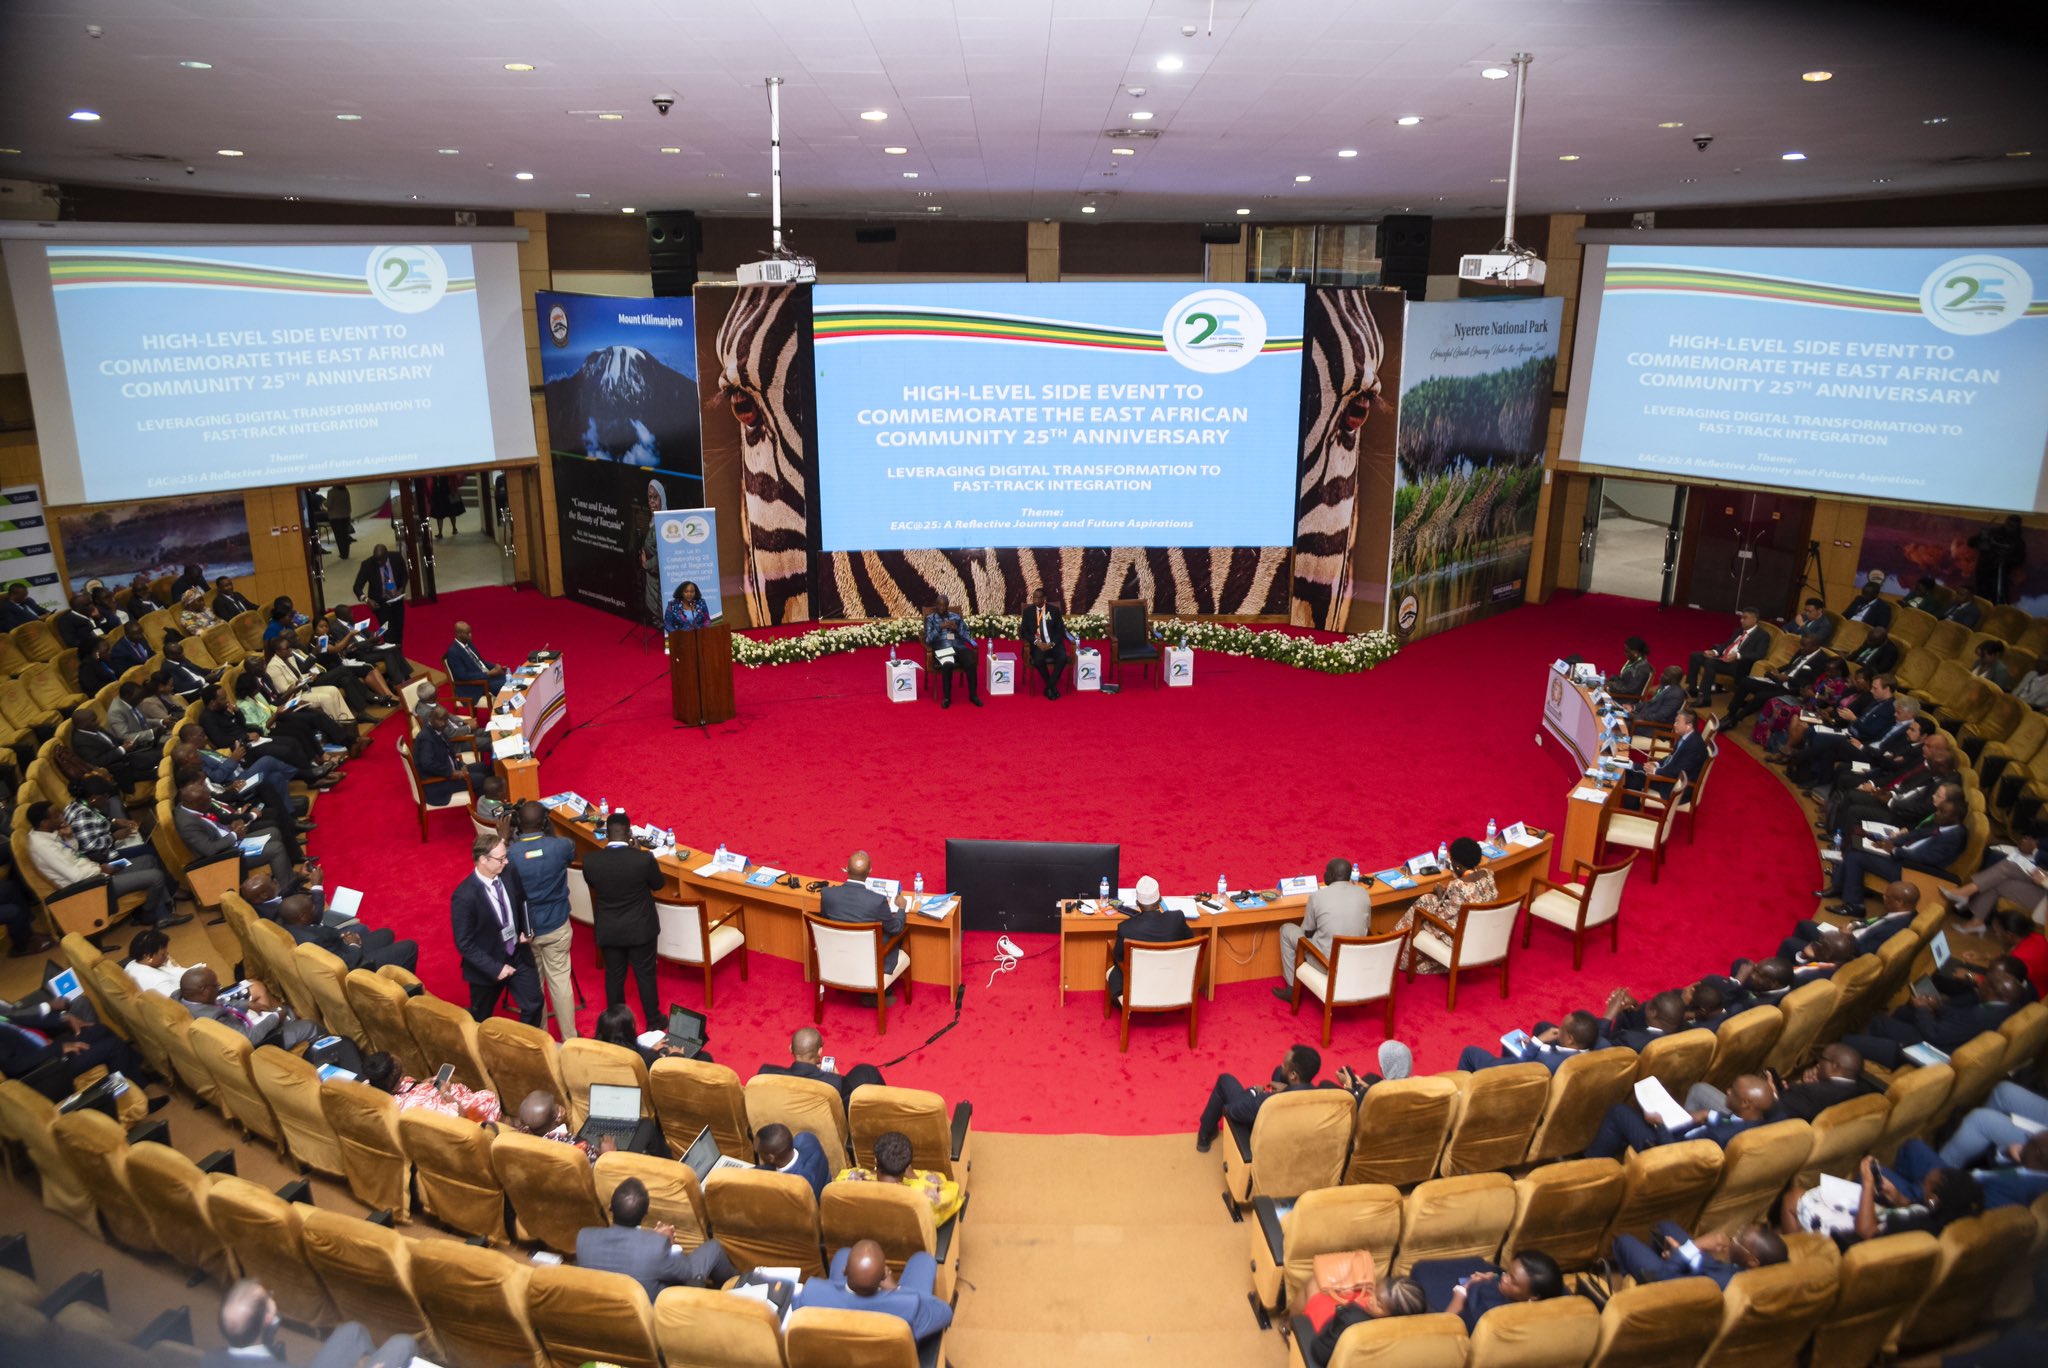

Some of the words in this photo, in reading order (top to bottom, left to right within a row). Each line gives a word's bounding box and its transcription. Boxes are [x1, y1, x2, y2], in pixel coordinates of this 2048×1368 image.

[1944, 276, 2006, 307] 25
[618, 313, 641, 325] Mount
[641, 313, 683, 328] Kilimanjaro
[1185, 312, 1242, 344] 25
[1454, 323, 1490, 340] Nyerere
[1491, 320, 1528, 335] National
[1528, 319, 1548, 333] Park
[143, 330, 267, 350] HIGH-LEVEL
[272, 328, 316, 344] SIDE
[320, 325, 379, 342] EVENT
[382, 324, 407, 339] TO
[1668, 335, 1787, 353] HIGH-LEVEL
[1793, 340, 1840, 356] SIDE
[1846, 342, 1919, 359] EVENT
[1923, 344, 1955, 360] TO
[99, 352, 272, 376] COMMEMORATE
[274, 350, 313, 366] THE
[317, 347, 362, 364] EAST
[367, 343, 445, 361] AFRICAN
[1627, 352, 1786, 374] COMMEMORATE
[1791, 360, 1831, 376] THE
[1836, 363, 1891, 379] EAST
[1895, 365, 2000, 384] AFRICAN
[121, 375, 255, 398] COMMUNITY
[305, 364, 433, 387] ANNIVERSARY
[903, 384, 1036, 401] HIGH-LEVEL
[1042, 384, 1092, 400] SIDE
[1097, 384, 1170, 400] EVENT
[1174, 384, 1204, 400] TO
[1639, 372, 1765, 393] COMMUNITY
[1815, 383, 1977, 405] ANNIVERSARY
[137, 413, 232, 431] LEVERAGING
[235, 409, 289, 424] DIGITAL
[293, 399, 413, 419] TRANSFORMATION
[414, 398, 432, 409] TO
[857, 407, 1038, 425] COMMEMORATE
[1042, 406, 1085, 422] THE
[1090, 406, 1146, 422] EAST
[1150, 407, 1248, 423] AFRICAN
[1643, 405, 1730, 421] LEVERAGING
[1734, 411, 1790, 425] DIGITAL
[1793, 414, 1937, 435] TRANSFORMATION
[1940, 424, 1963, 436] TO
[203, 425, 287, 442] FAST-TRACK
[290, 417, 379, 435] INTEGRATION
[876, 429, 1017, 447] COMMUNITY
[1023, 428, 1068, 445] 25TH
[1072, 429, 1230, 444] ANNIVERSARY
[1698, 422, 1783, 439] FAST-TRACK
[1785, 429, 1888, 446] INTEGRATION
[199, 472, 208, 482] A
[209, 467, 263, 481] Reflective
[265, 462, 305, 476] Journey
[307, 460, 328, 471] and
[329, 457, 363, 469] Future
[363, 452, 418, 466] Aspirations
[269, 453, 309, 463] Theme:
[1757, 452, 1798, 464] Theme:
[887, 466, 986, 479] LEVERAGING
[989, 465, 1050, 476] DIGITAL
[1053, 464, 1197, 476] TRANSFORMATION
[1199, 464, 1221, 476] TO
[1682, 457, 1693, 466] A
[1694, 458, 1746, 471] Reflective
[1747, 463, 1792, 477] Journey
[1793, 469, 1816, 477] and
[1817, 468, 1856, 480] Future
[1857, 472, 1927, 487] Aspirations
[953, 480, 1045, 492] FAST-TRACK
[1048, 479, 1152, 491] INTEGRATION
[1021, 507, 1064, 517] Theme:
[890, 521, 942, 531] EAC@25:
[943, 520, 952, 529] A
[954, 519, 1011, 529] Reflective
[1013, 519, 1060, 530] Journey
[1062, 519, 1085, 528] and
[1086, 519, 1126, 528] Future
[1126, 519, 1194, 530] Aspirations
